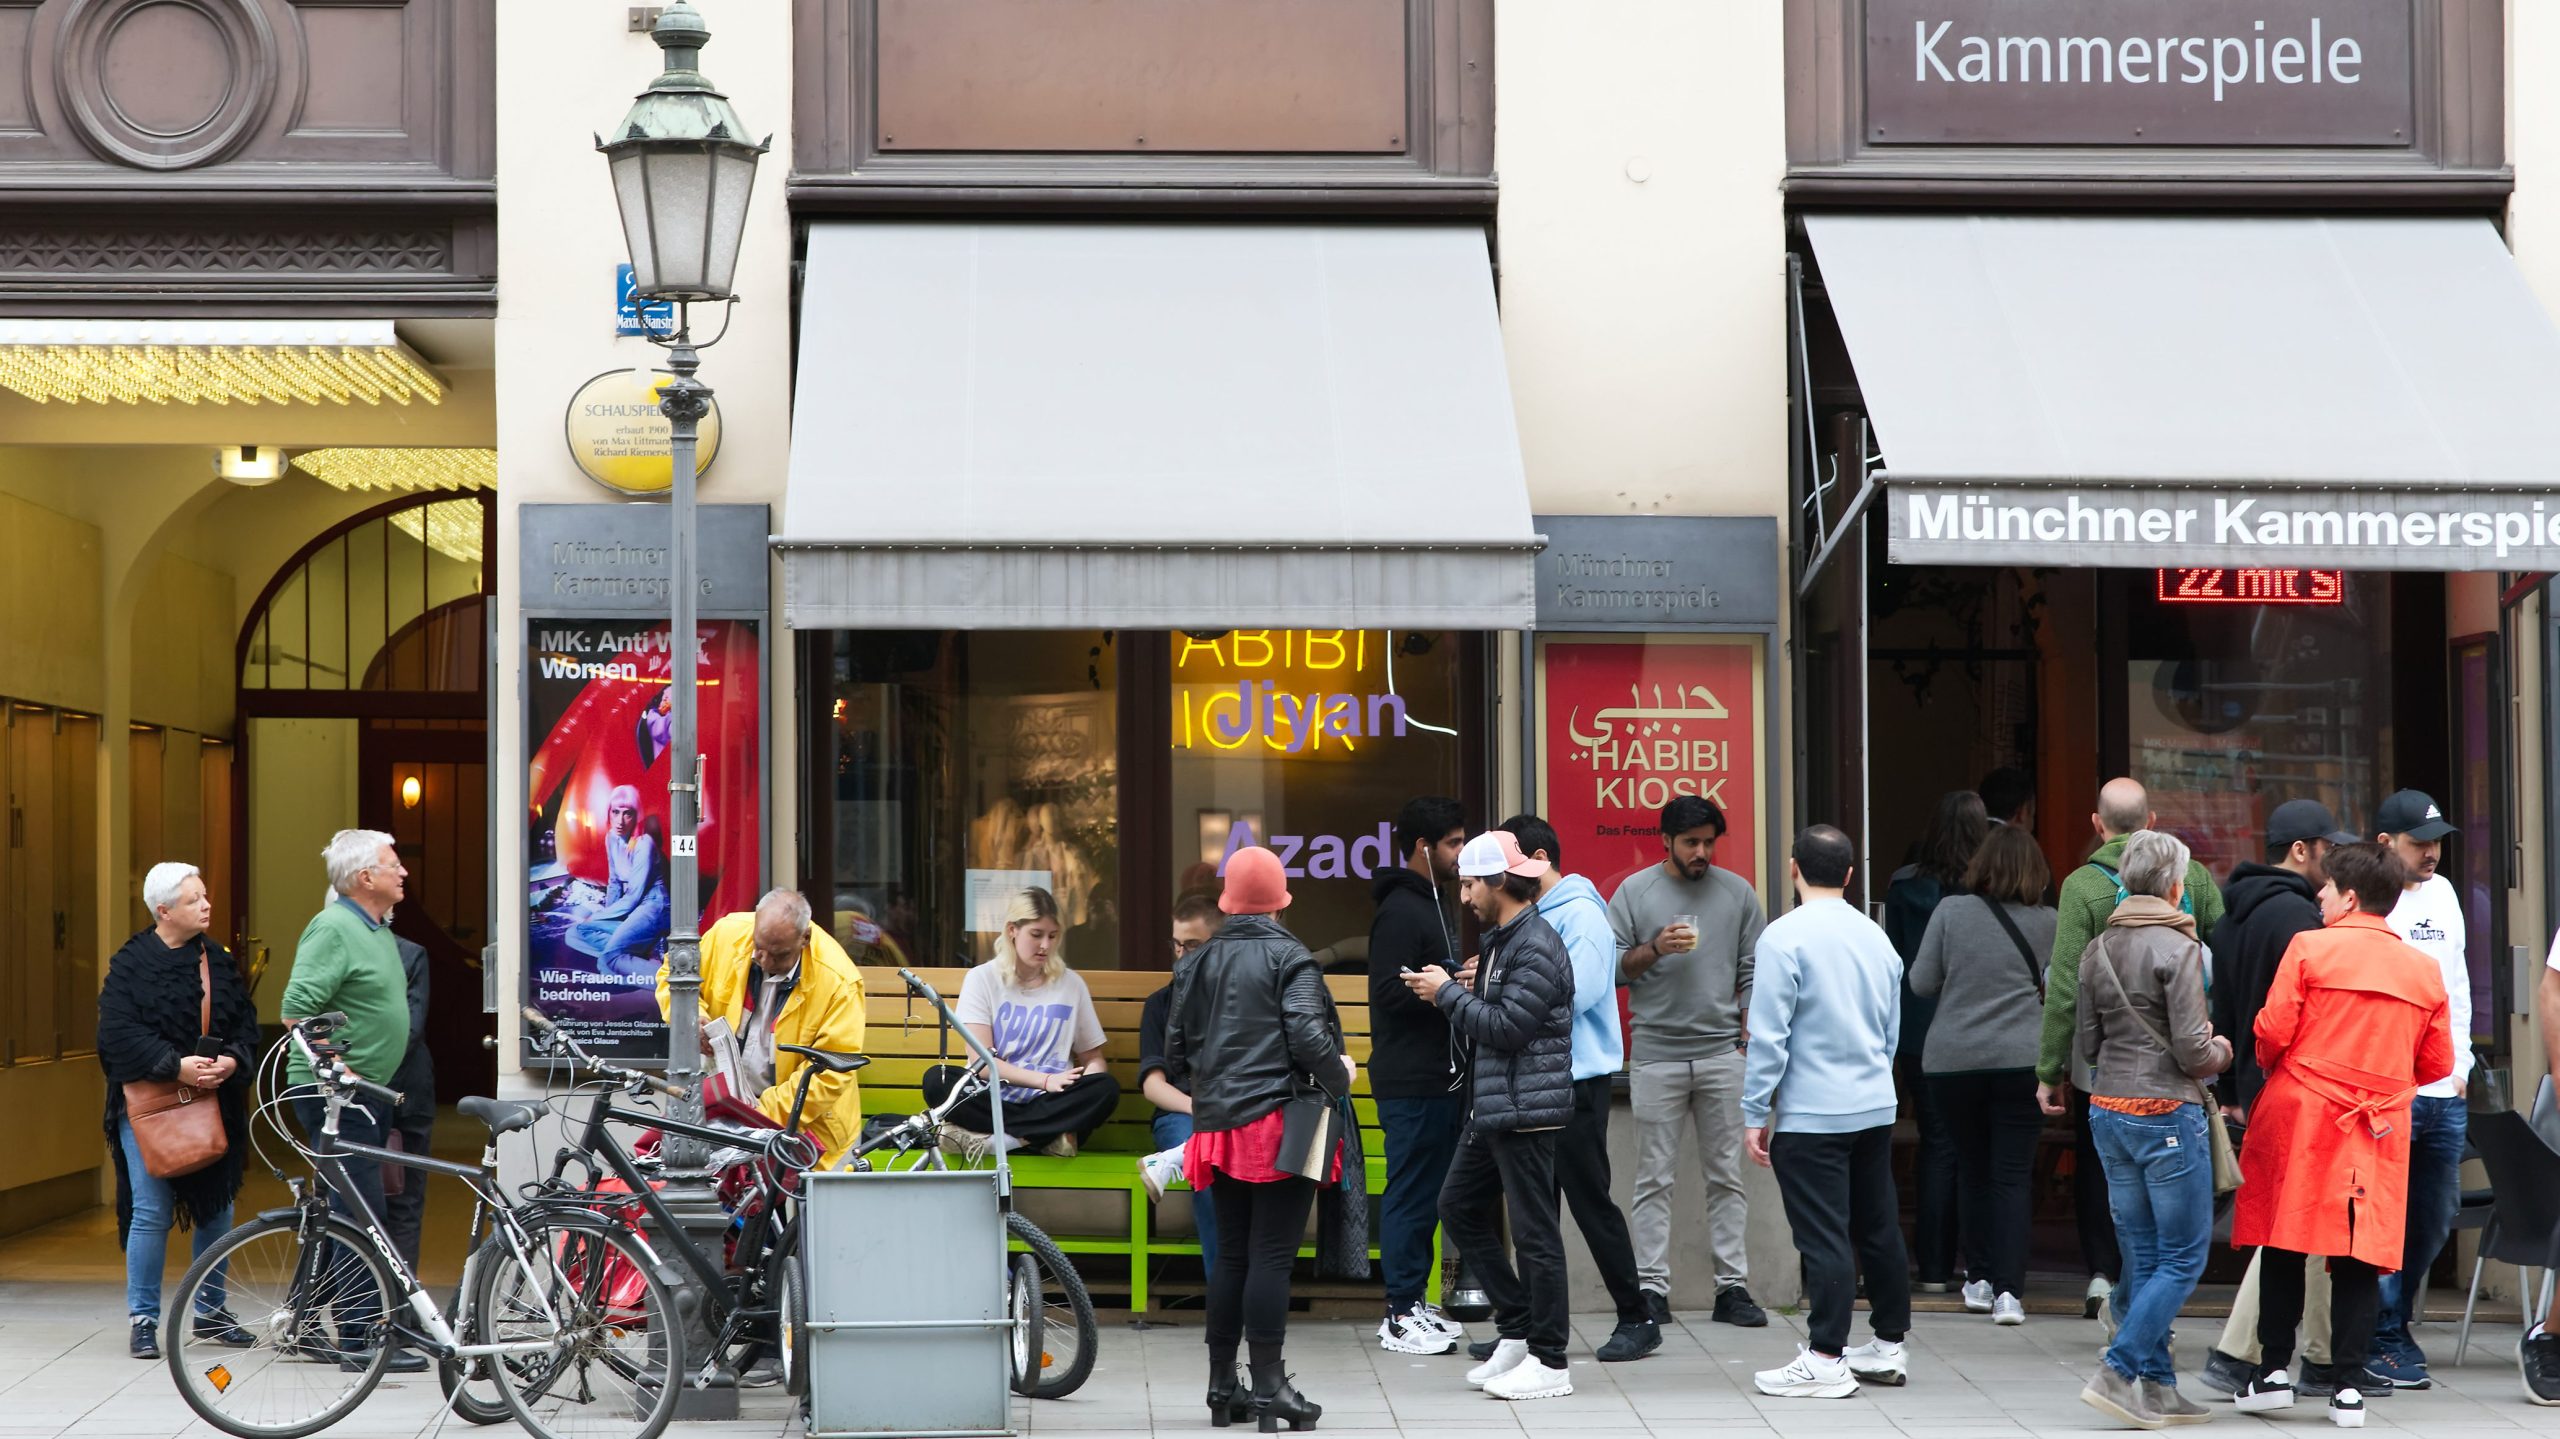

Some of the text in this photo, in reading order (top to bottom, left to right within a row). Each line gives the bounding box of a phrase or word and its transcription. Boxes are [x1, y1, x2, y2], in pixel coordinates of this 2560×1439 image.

[1915, 18, 2363, 101] Kammerspiele
[585, 405, 664, 417] SCHAUSPIEL
[612, 437, 631, 446] Max
[616, 426, 644, 435] erbaut
[594, 448, 672, 457] Richard Riemersch
[1907, 495, 2197, 545] Münchner
[553, 541, 667, 565] Münchner
[1556, 553, 1674, 578] Münchner
[553, 572, 713, 599] Kammerspe
[1556, 583, 1721, 613] Kammerspiele
[541, 631, 707, 653] MK: Anti Wr
[540, 657, 637, 680] Women
[1182, 690, 1354, 751] IOSK
[1217, 680, 1406, 752] Jiyan
[1592, 739, 1729, 772] HABIBI
[1596, 776, 1728, 810] KIOSK
[1597, 825, 1661, 837] Das Fenste
[1216, 820, 1408, 879] Azad
[540, 970, 654, 985] Wie Frauen den
[540, 988, 611, 1001] bedrohen
[555, 1021, 588, 1029] fführung
[607, 1029, 653, 1037] Jantschitsch
[594, 1037, 619, 1045] Glause
[311, 1240, 322, 1276] KOGA
[366, 1225, 411, 1292] KOGA
